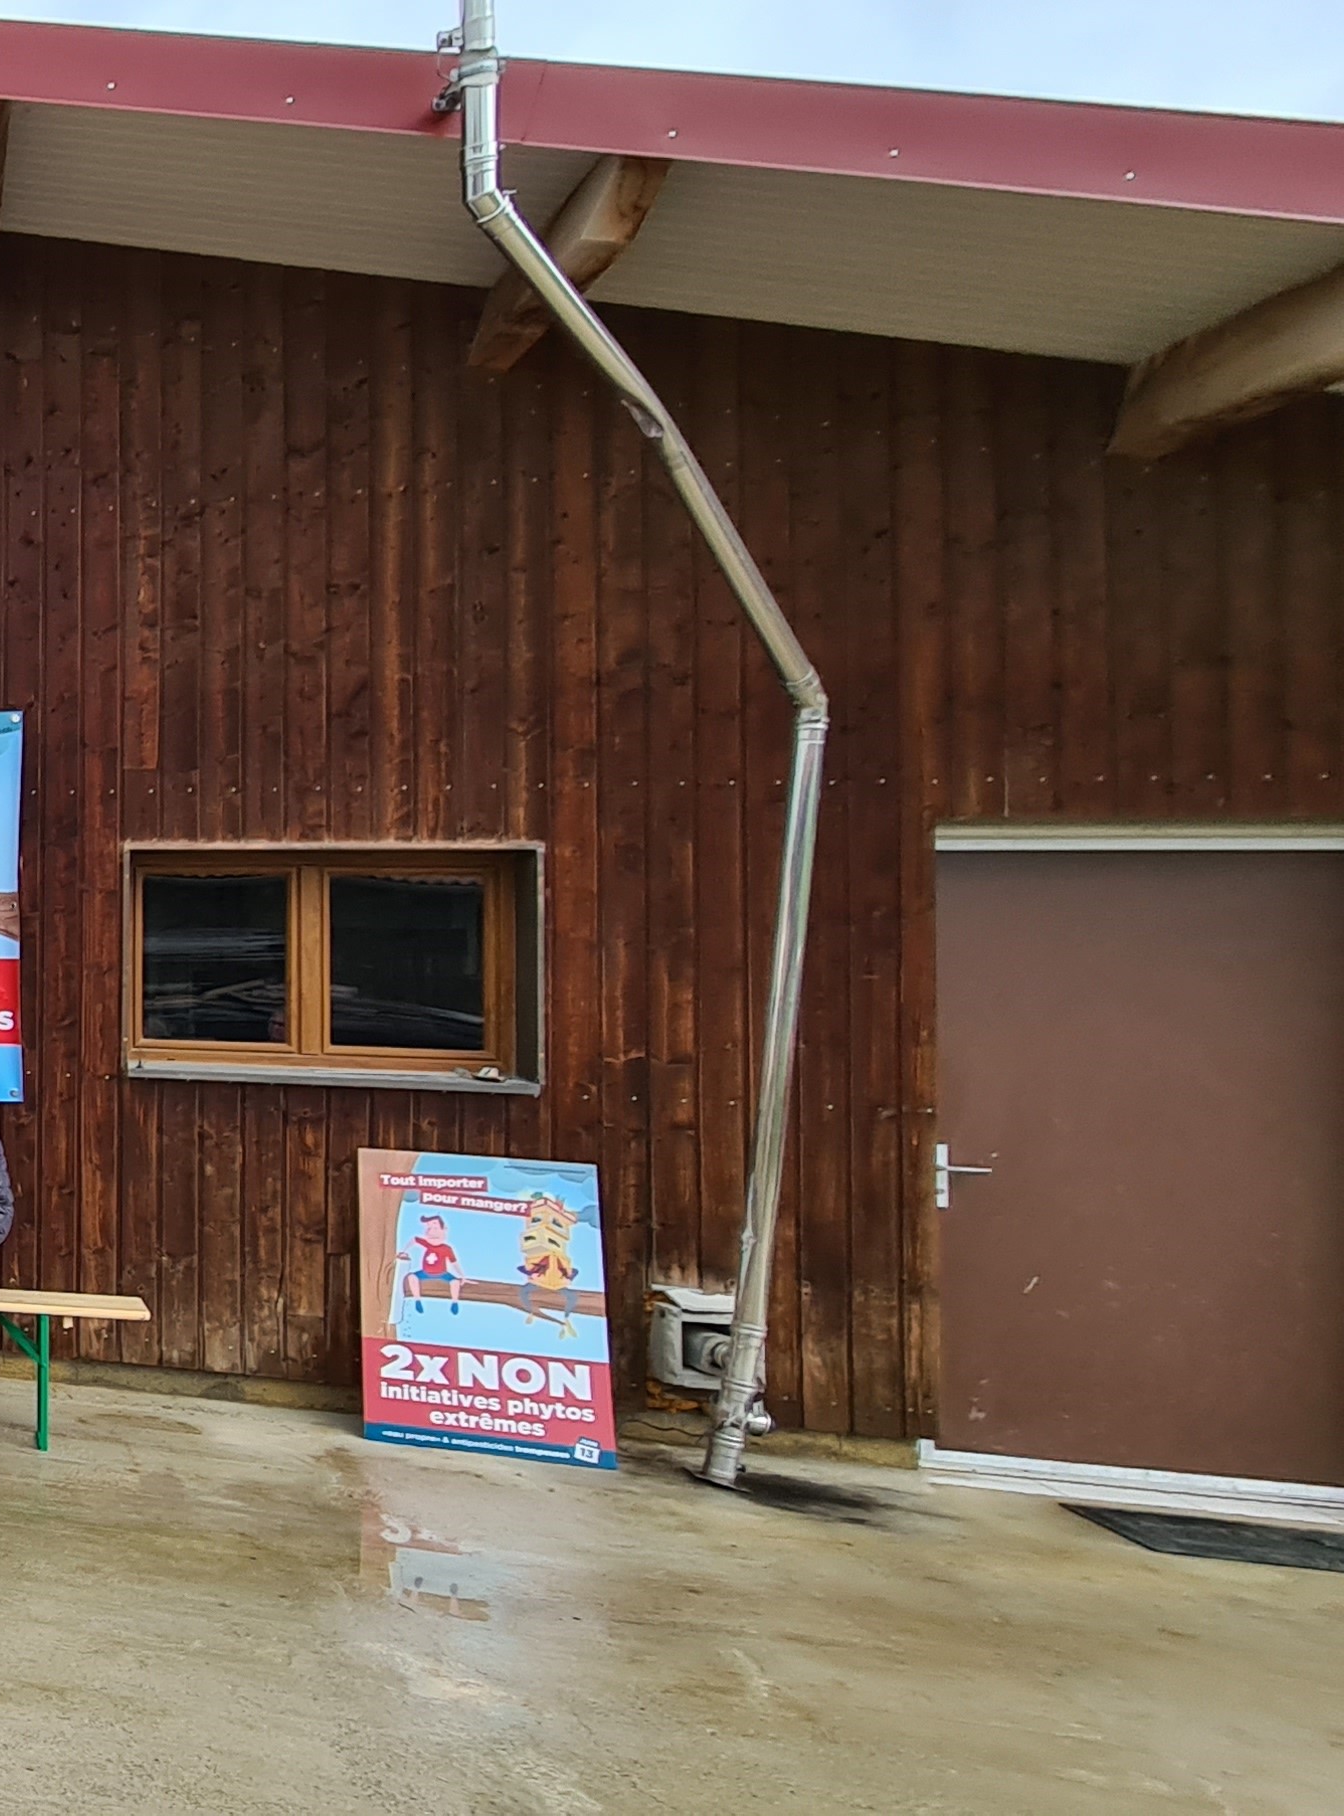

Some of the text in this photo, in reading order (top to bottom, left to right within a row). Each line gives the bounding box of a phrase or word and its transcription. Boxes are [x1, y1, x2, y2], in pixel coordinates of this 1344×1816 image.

[380, 1174, 484, 1189] Tout importer
[422, 1192, 528, 1213] pour manger?
[380, 1344, 592, 1401] 2x NON
[380, 1381, 596, 1423] initiatives phytos
[430, 1410, 545, 1437] extrêmes
